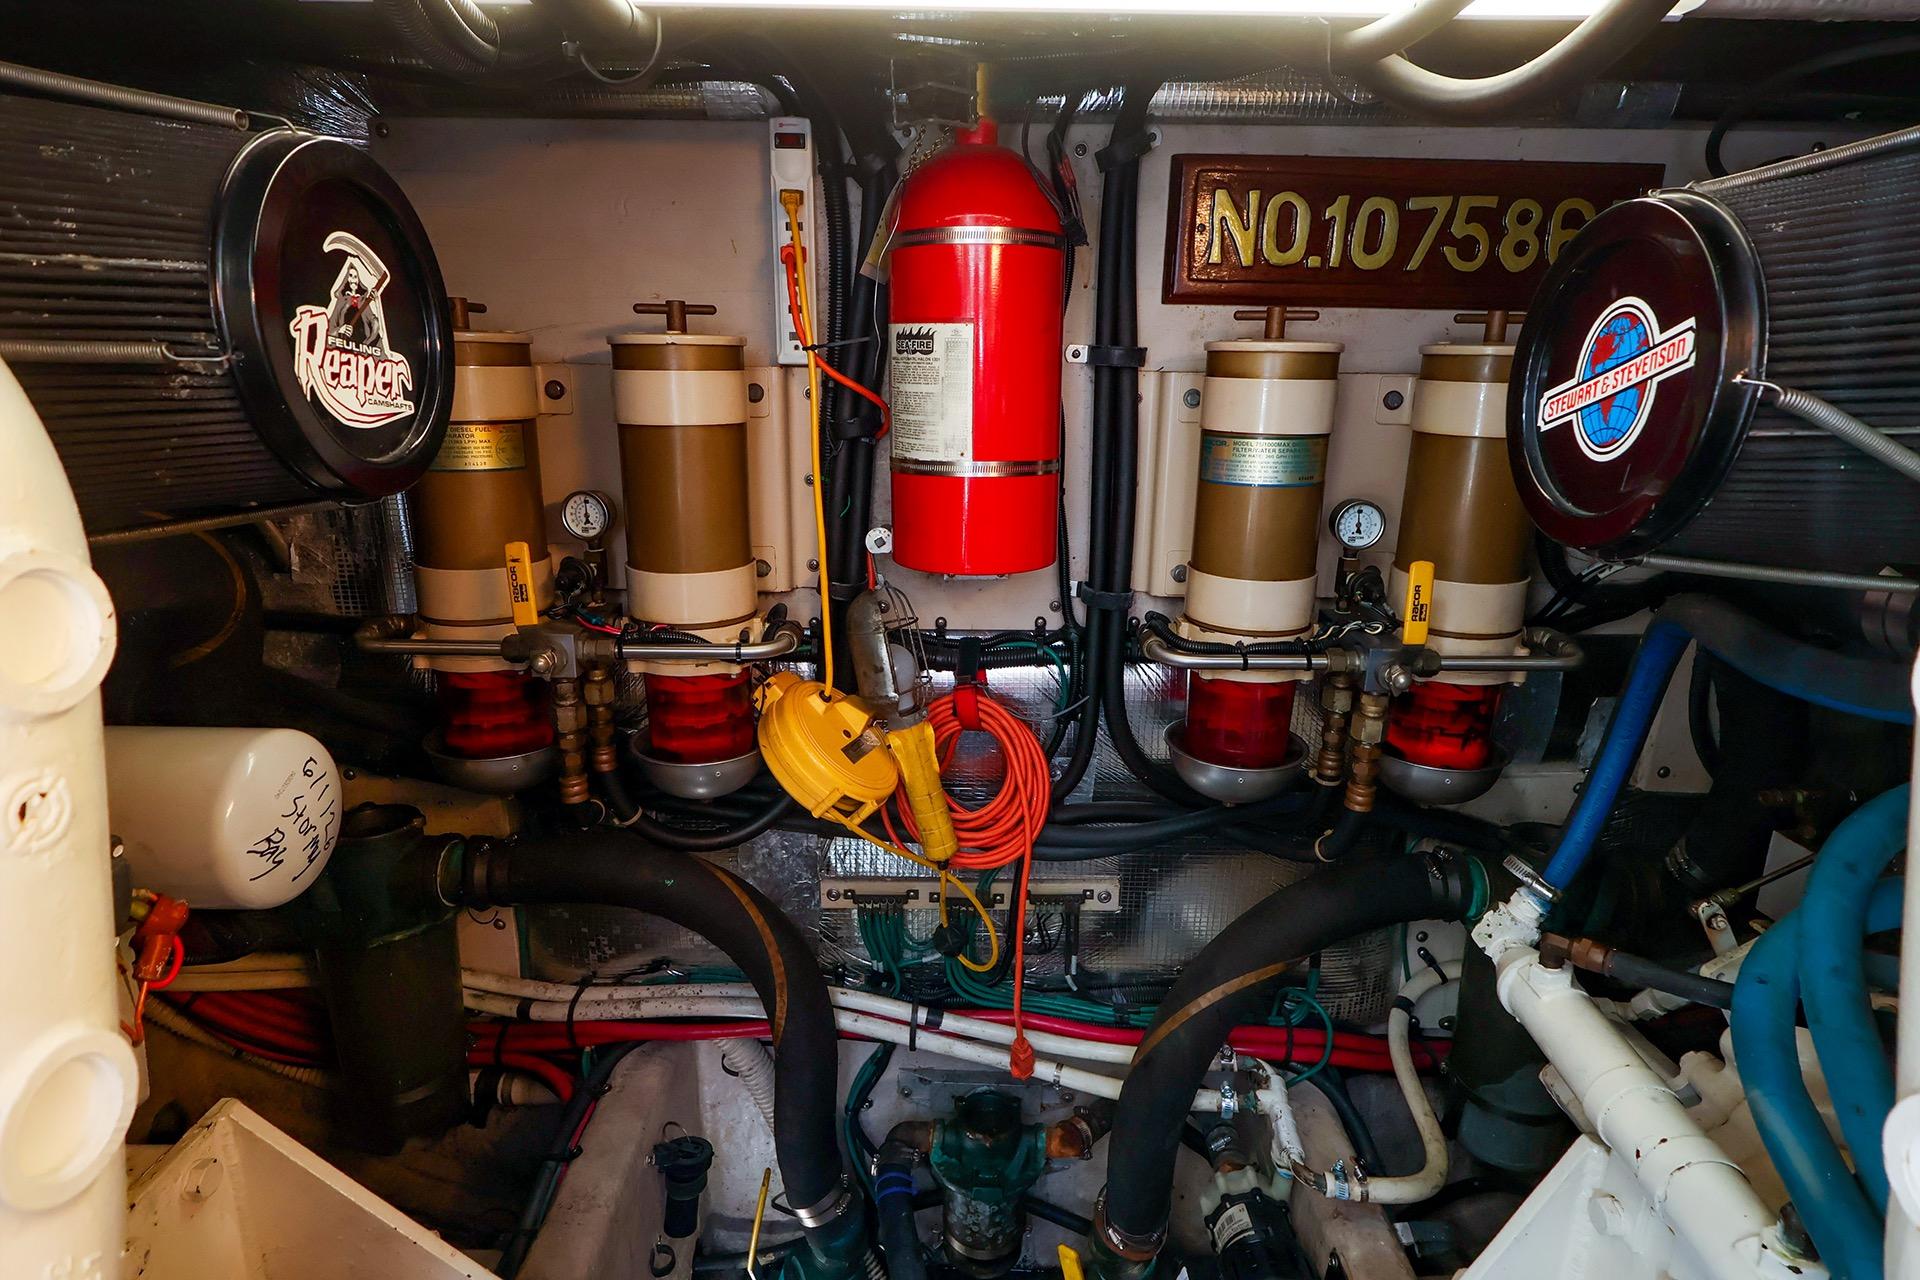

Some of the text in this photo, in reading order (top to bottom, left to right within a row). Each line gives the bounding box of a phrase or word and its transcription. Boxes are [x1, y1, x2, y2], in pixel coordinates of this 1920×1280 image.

[294, 310, 412, 407] Reaper
[328, 336, 381, 356] FEULING
[1548, 338, 1686, 417] STEWART & STEVENSON
[367, 398, 413, 411] CAMSHAFTS
